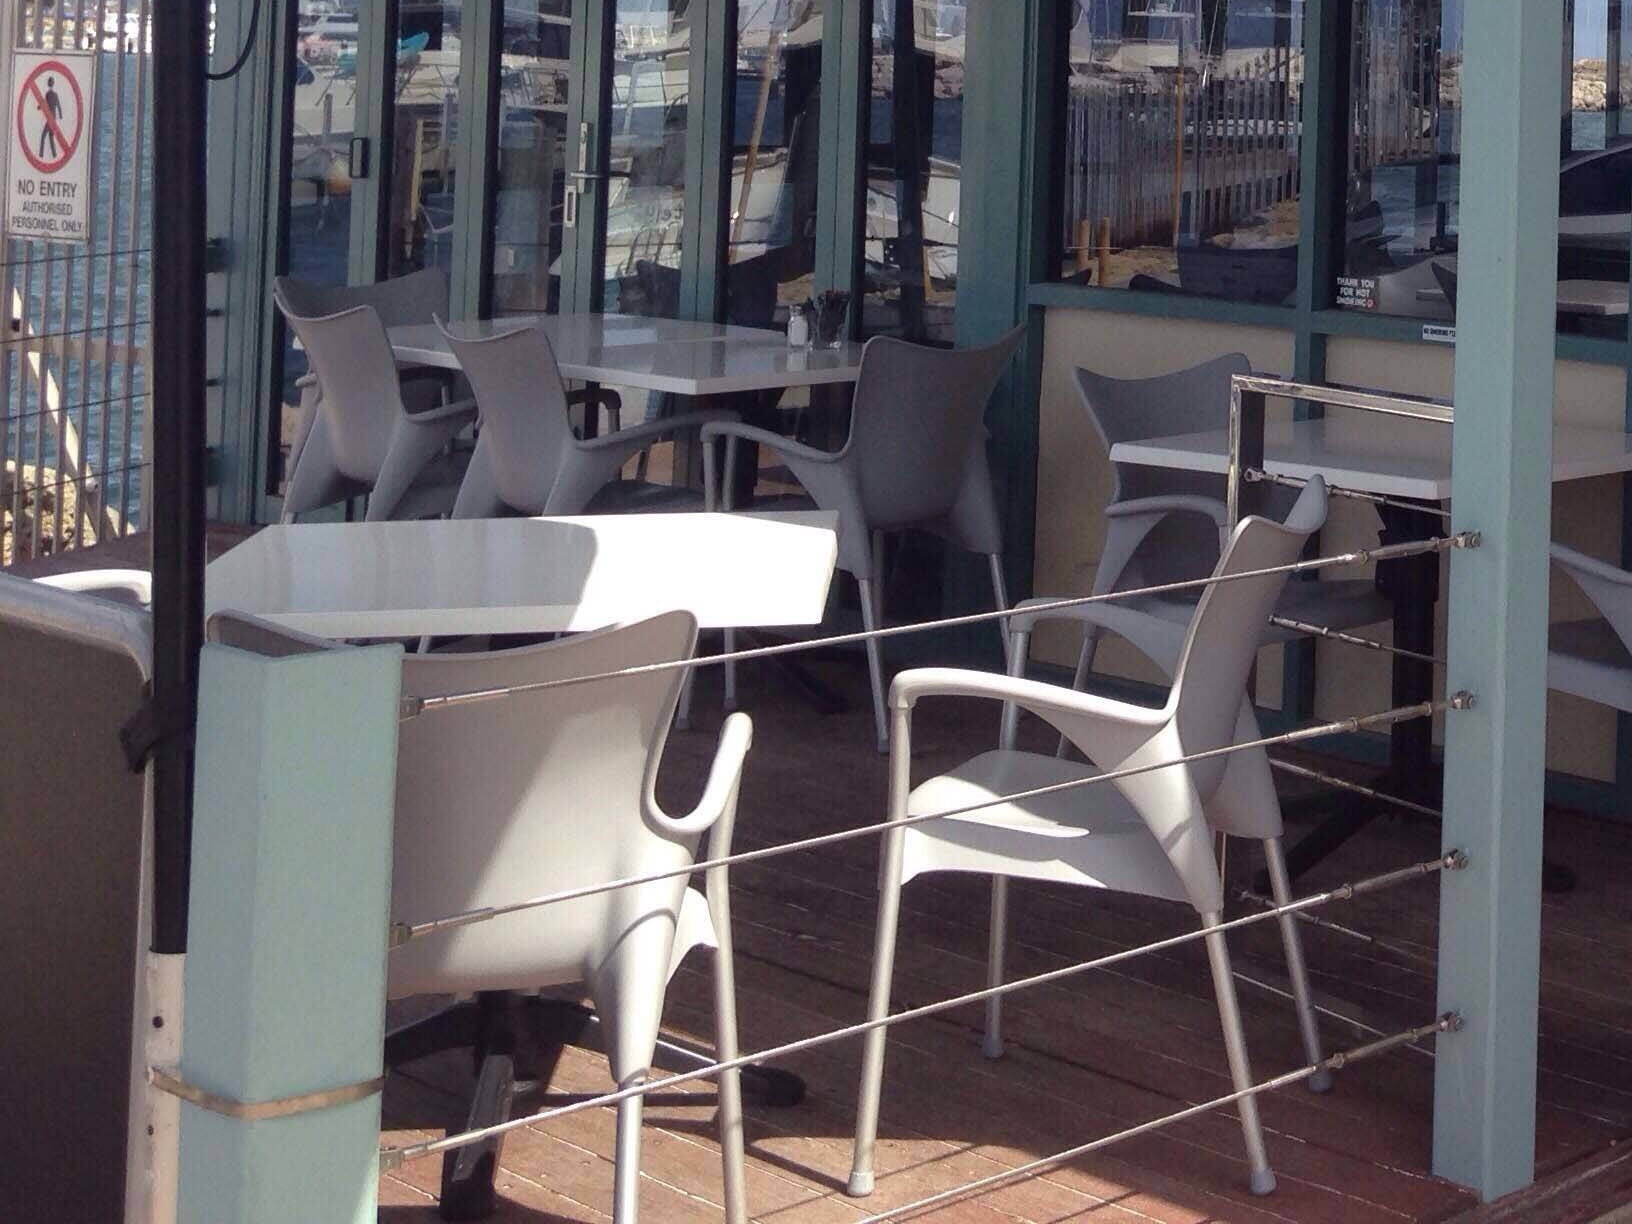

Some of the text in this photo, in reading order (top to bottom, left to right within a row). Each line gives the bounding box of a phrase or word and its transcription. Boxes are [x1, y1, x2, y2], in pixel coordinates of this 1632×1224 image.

[18, 179, 77, 197] NO ENTRY
[22, 200, 73, 216] AUTHORISED
[12, 216, 83, 232] PERSONNEL ONLY
